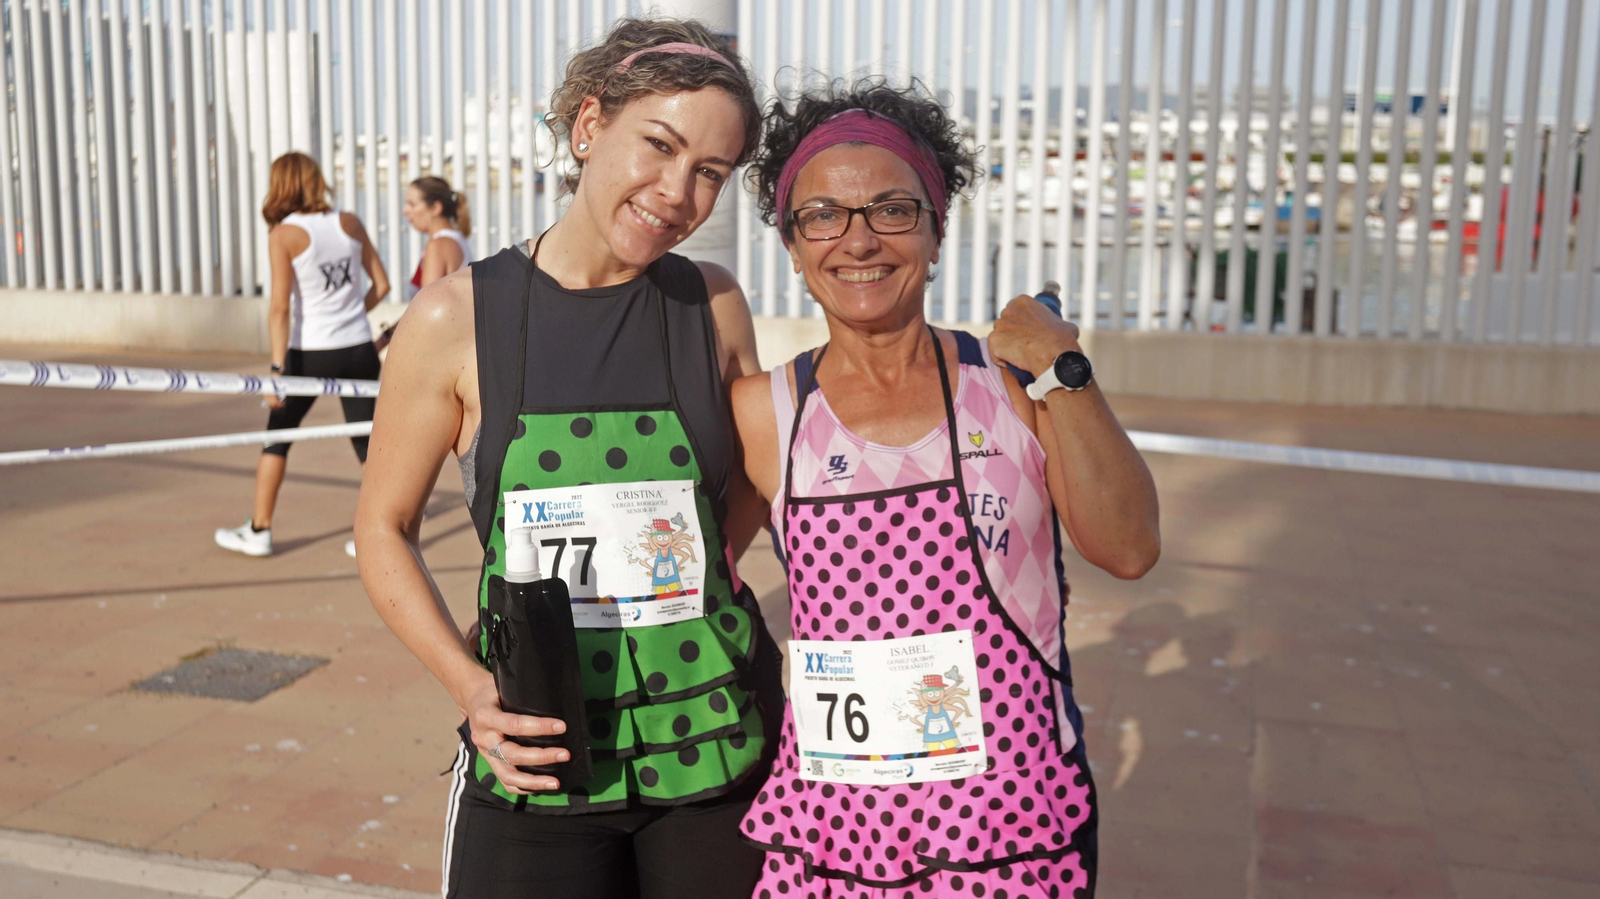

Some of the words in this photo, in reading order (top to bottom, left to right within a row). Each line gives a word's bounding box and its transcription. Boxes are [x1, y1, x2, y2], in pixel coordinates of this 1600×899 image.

[959, 449, 1003, 460] SPALL
[616, 489, 662, 500] CRISTINA
[547, 500, 582, 511] Carrera
[522, 501, 548, 523] XX
[548, 510, 584, 522] Popular
[540, 536, 597, 586] 77
[890, 644, 930, 656] ISABEL
[805, 652, 825, 673] XX
[824, 653, 852, 663] Carrera
[824, 664, 854, 675] Popular
[816, 693, 869, 743] 76
[873, 768, 904, 777] Algeciras
